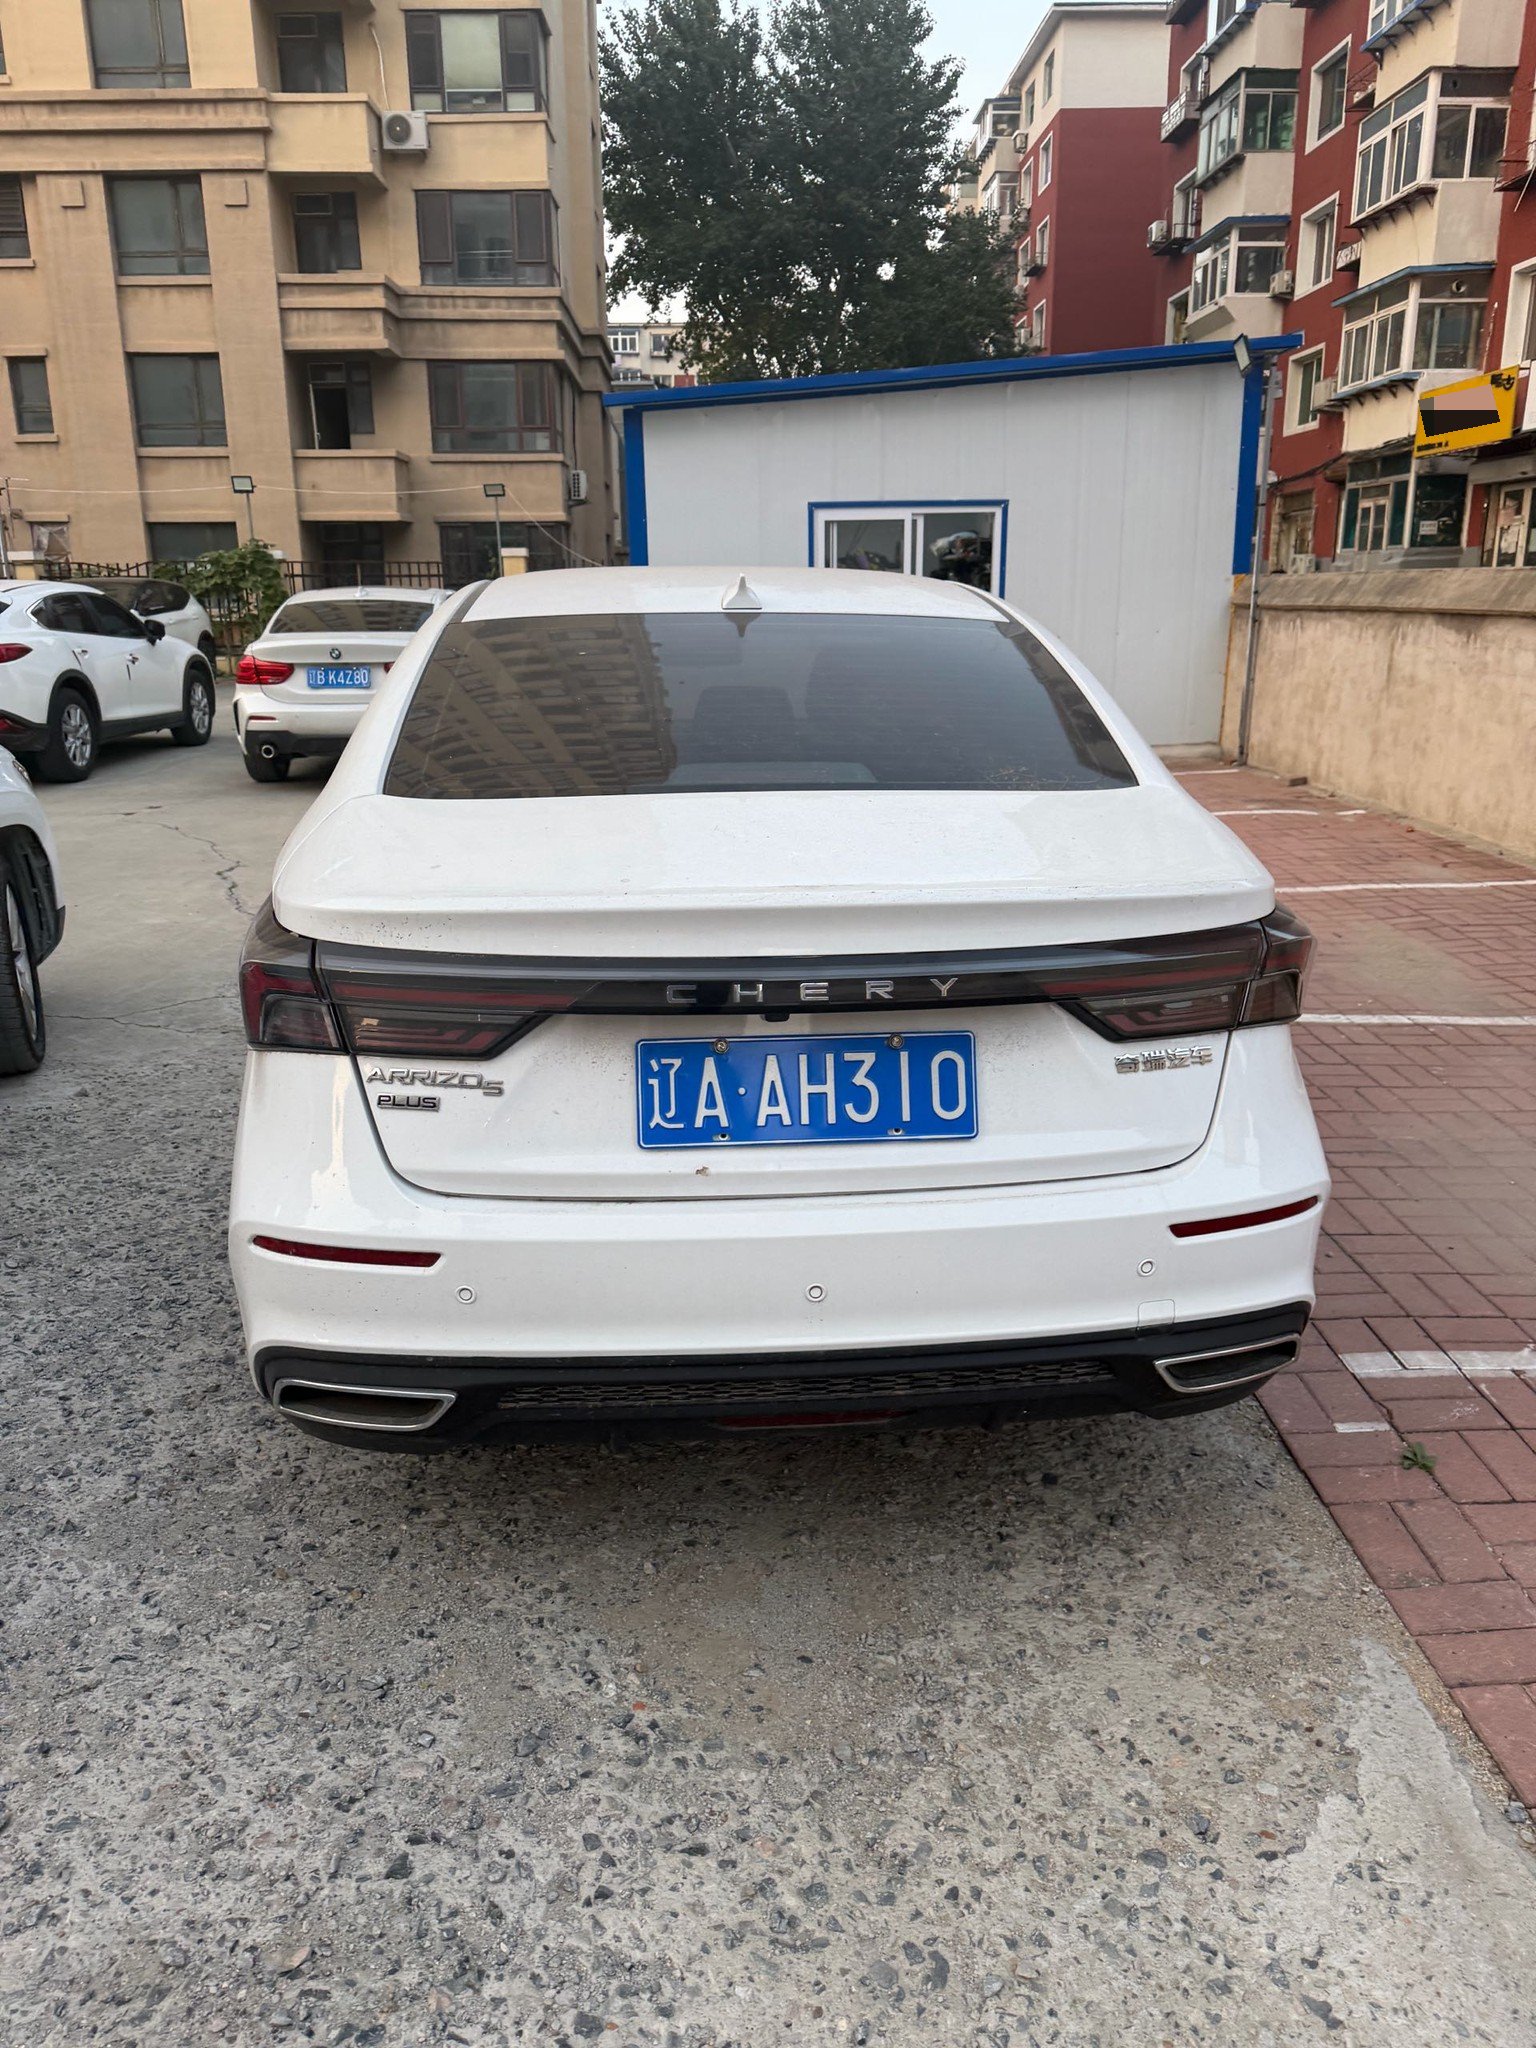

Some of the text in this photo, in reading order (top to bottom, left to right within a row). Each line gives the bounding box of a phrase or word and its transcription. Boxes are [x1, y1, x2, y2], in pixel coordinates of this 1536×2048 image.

[666, 977, 959, 1003] CHERY
[1114, 1045, 1214, 1073] 奇瑞汽车
[377, 1093, 440, 1112] PLUS
